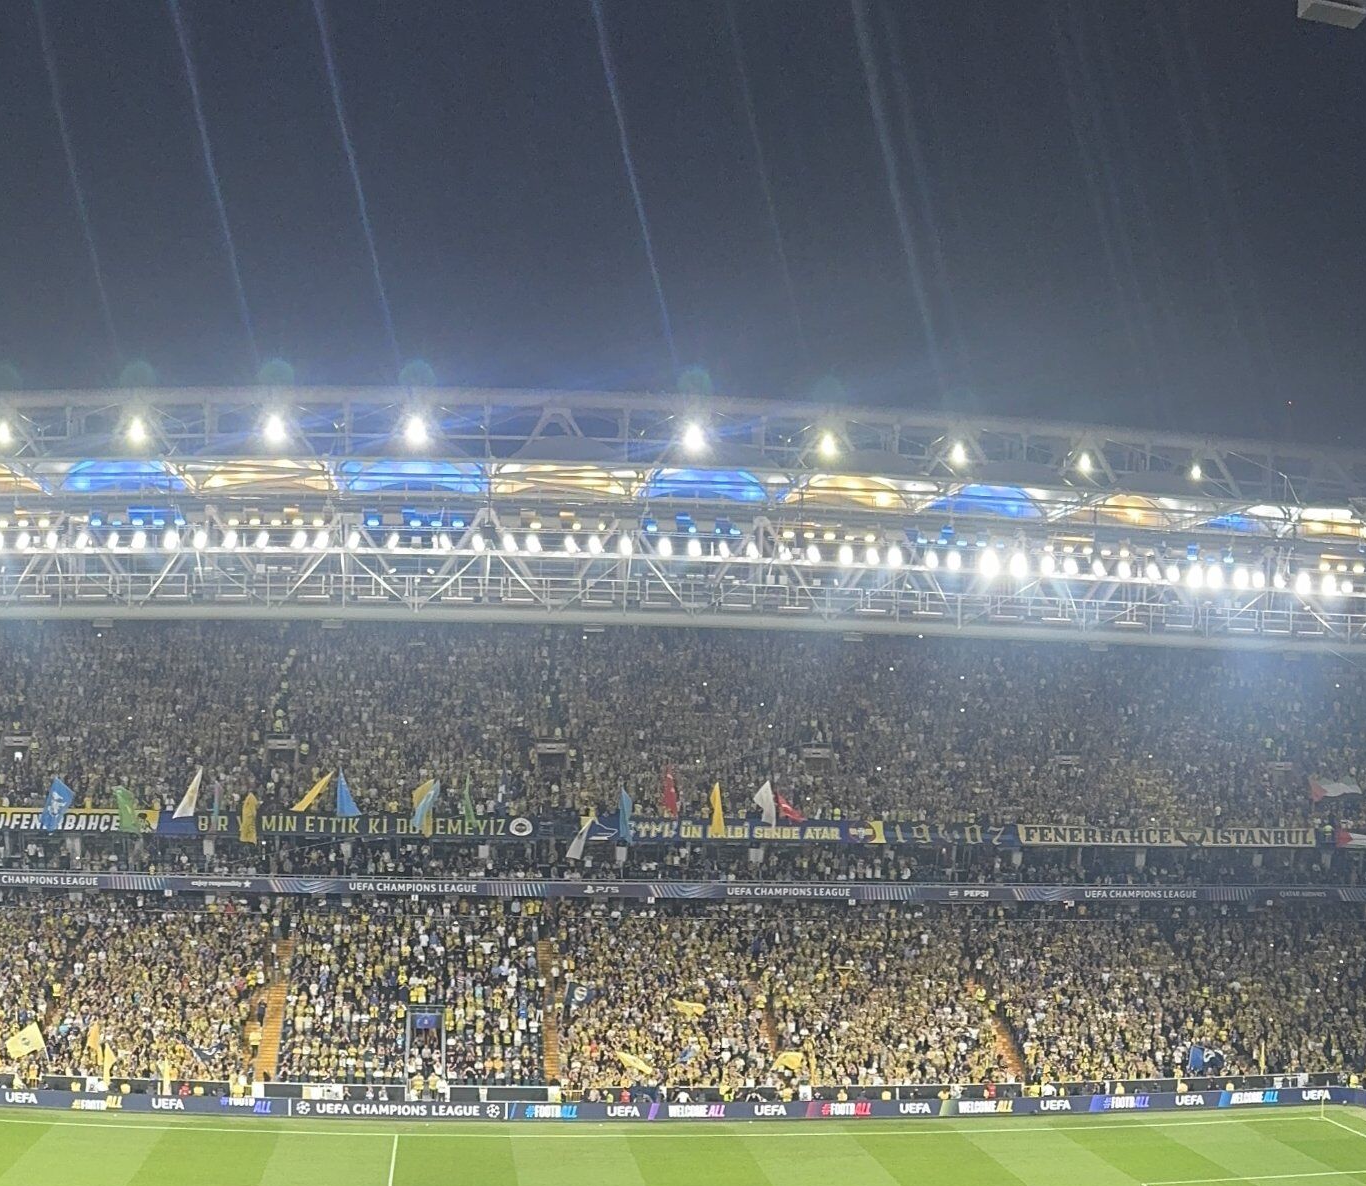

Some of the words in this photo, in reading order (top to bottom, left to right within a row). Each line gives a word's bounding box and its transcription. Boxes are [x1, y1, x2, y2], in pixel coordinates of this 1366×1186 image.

[10, 812, 120, 834] FENBAHÇE
[198, 814, 228, 832] BR
[237, 814, 297, 833] MİN
[397, 816, 506, 836] DEMEYİZ
[706, 821, 750, 838] KLBİ
[803, 826, 841, 840] ATAR
[2, 874, 59, 885] CHAMPIONS
[61, 876, 98, 886] LEAGUE
[349, 882, 374, 891] UEFA
[376, 882, 437, 892] CHAMPIONS
[438, 883, 478, 893] LEAGUE
[596, 885, 619, 893] PS5
[727, 887, 752, 896] UEFA
[754, 887, 812, 897] CHAMPIONS
[814, 887, 851, 897] LEAGUE
[964, 889, 989, 898] PEPSI
[1085, 890, 1106, 898] UEFA
[1109, 890, 1162, 899] CHAMPIONS
[1163, 890, 1197, 899] LEAGUE
[5, 1092, 37, 1104] UEFA
[1175, 1094, 1204, 1106] UEFA
[1302, 1089, 1331, 1101] UEFA
[152, 1097, 185, 1110] UEFA
[822, 1102, 872, 1116] #FOOTBALL
[899, 1103, 931, 1114] UEFA
[1040, 1099, 1071, 1111] UEFA
[316, 1103, 350, 1115] UEFA
[352, 1103, 427, 1117] CHAMPIONS
[432, 1104, 480, 1117] LEAGUE
[525, 1104, 578, 1119] #FOOTBALL
[607, 1105, 640, 1117] UEFA
[754, 1104, 787, 1116] UEFA
